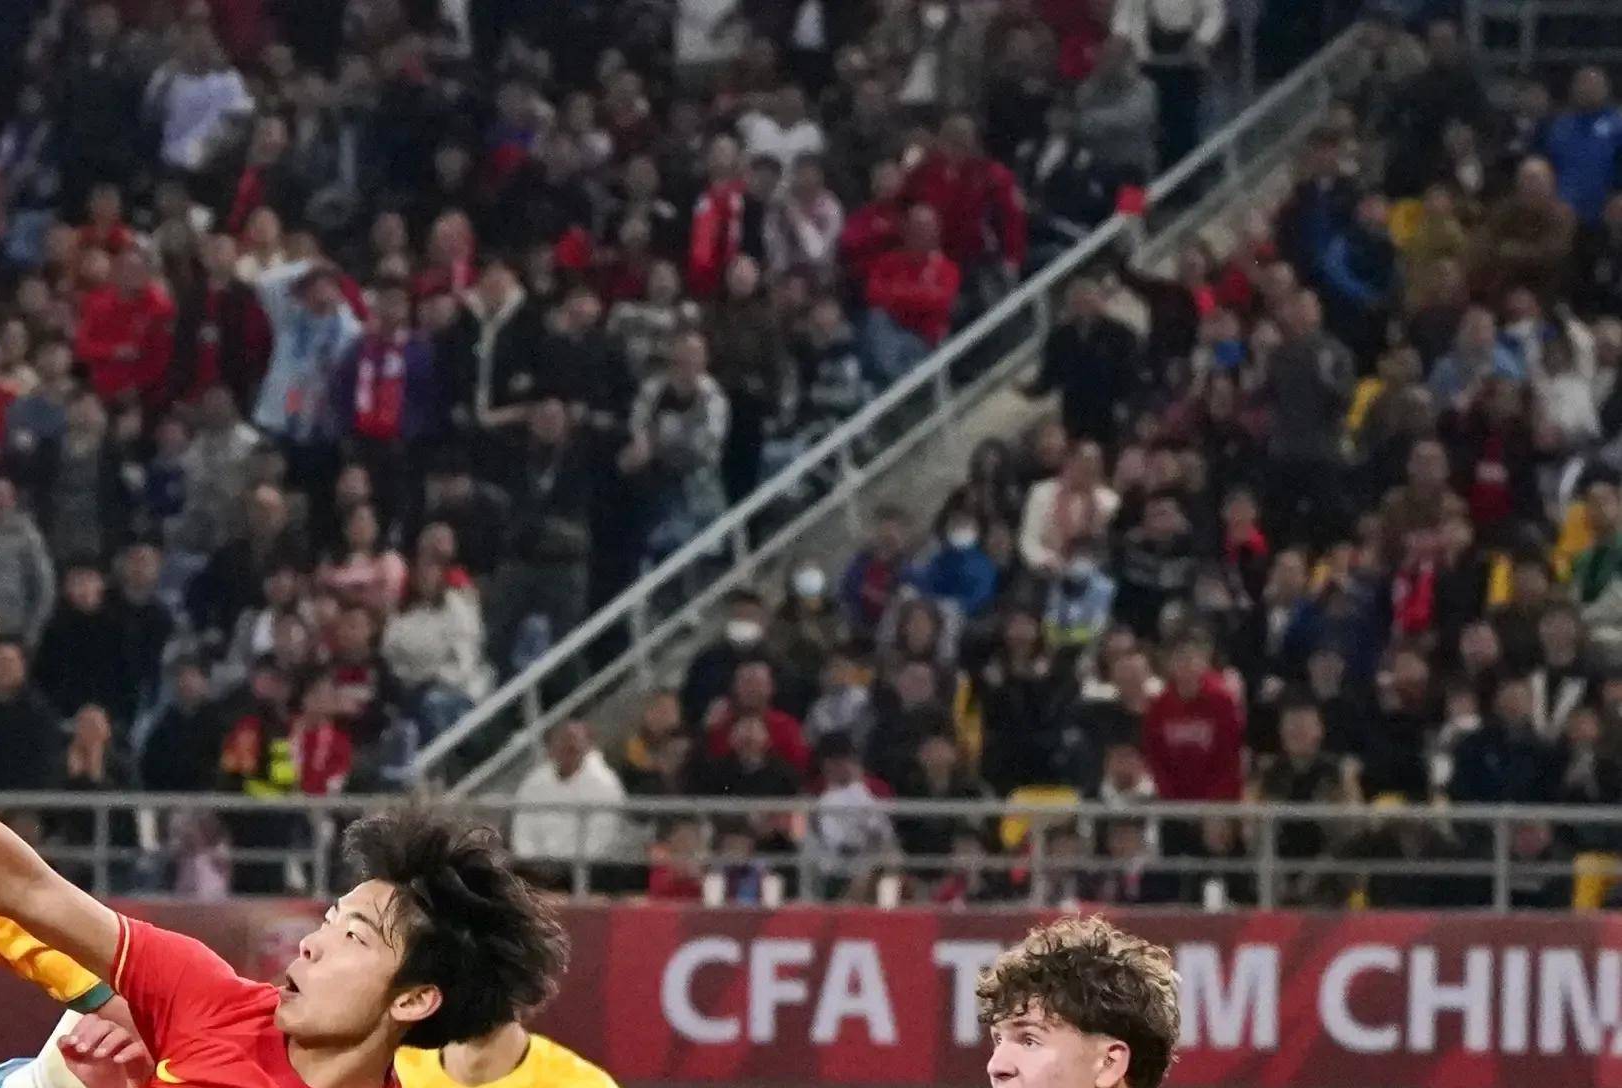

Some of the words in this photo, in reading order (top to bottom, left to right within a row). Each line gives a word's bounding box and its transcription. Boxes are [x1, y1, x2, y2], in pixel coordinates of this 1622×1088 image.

[660, 936, 898, 1045] CFA
[931, 939, 1280, 1051] TM
[1318, 943, 1622, 1054] CHIN
